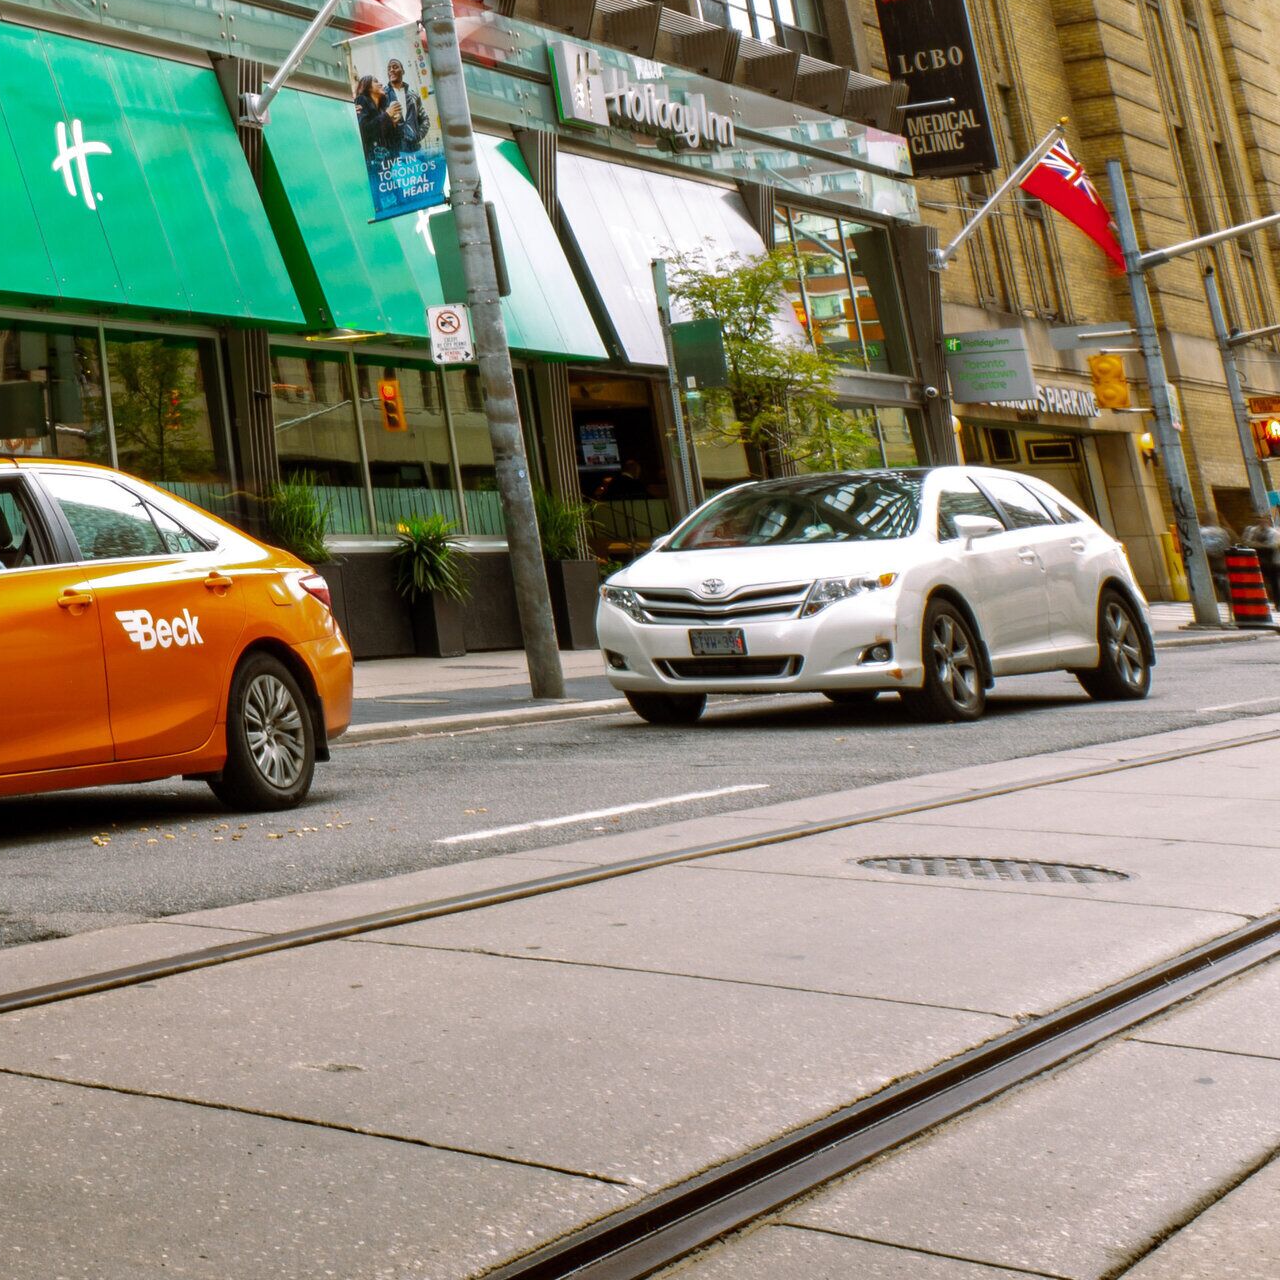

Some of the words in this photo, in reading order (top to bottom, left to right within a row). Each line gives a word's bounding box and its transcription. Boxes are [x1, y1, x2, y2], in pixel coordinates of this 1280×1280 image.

[897, 45, 964, 74] LCBO
[604, 69, 699, 148] Holiday
[689, 92, 736, 147] Inn
[907, 109, 981, 137] MEDICAL
[911, 130, 965, 155] CLINIC
[378, 160, 436, 182] TORONTO'S
[381, 156, 402, 171] LIVE
[405, 154, 417, 165] IN
[378, 175, 429, 193] CULTURAL
[403, 181, 435, 198] HEART
[963, 360, 1007, 370] Toronto
[970, 380, 1008, 391] Centre
[138, 608, 204, 651] Beck
